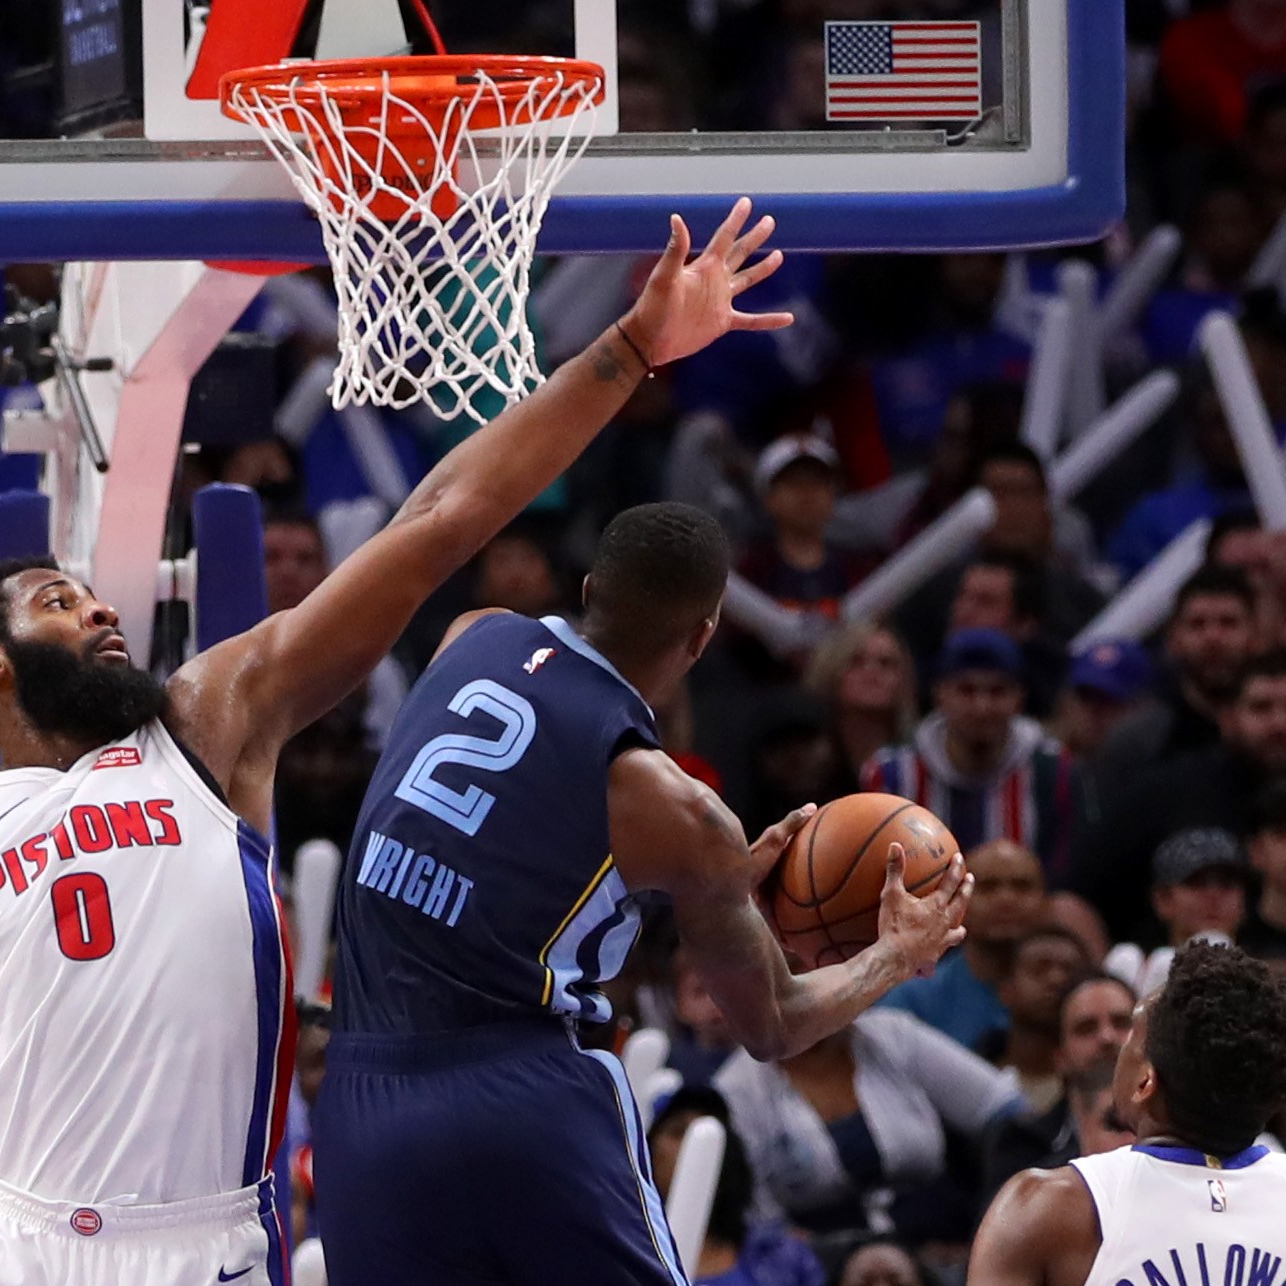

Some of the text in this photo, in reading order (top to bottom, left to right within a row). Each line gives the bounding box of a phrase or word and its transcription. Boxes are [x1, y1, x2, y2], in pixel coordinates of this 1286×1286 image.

[394, 678, 537, 837] 2
[51, 871, 115, 962] 0
[356, 830, 474, 928] WRIGHT
